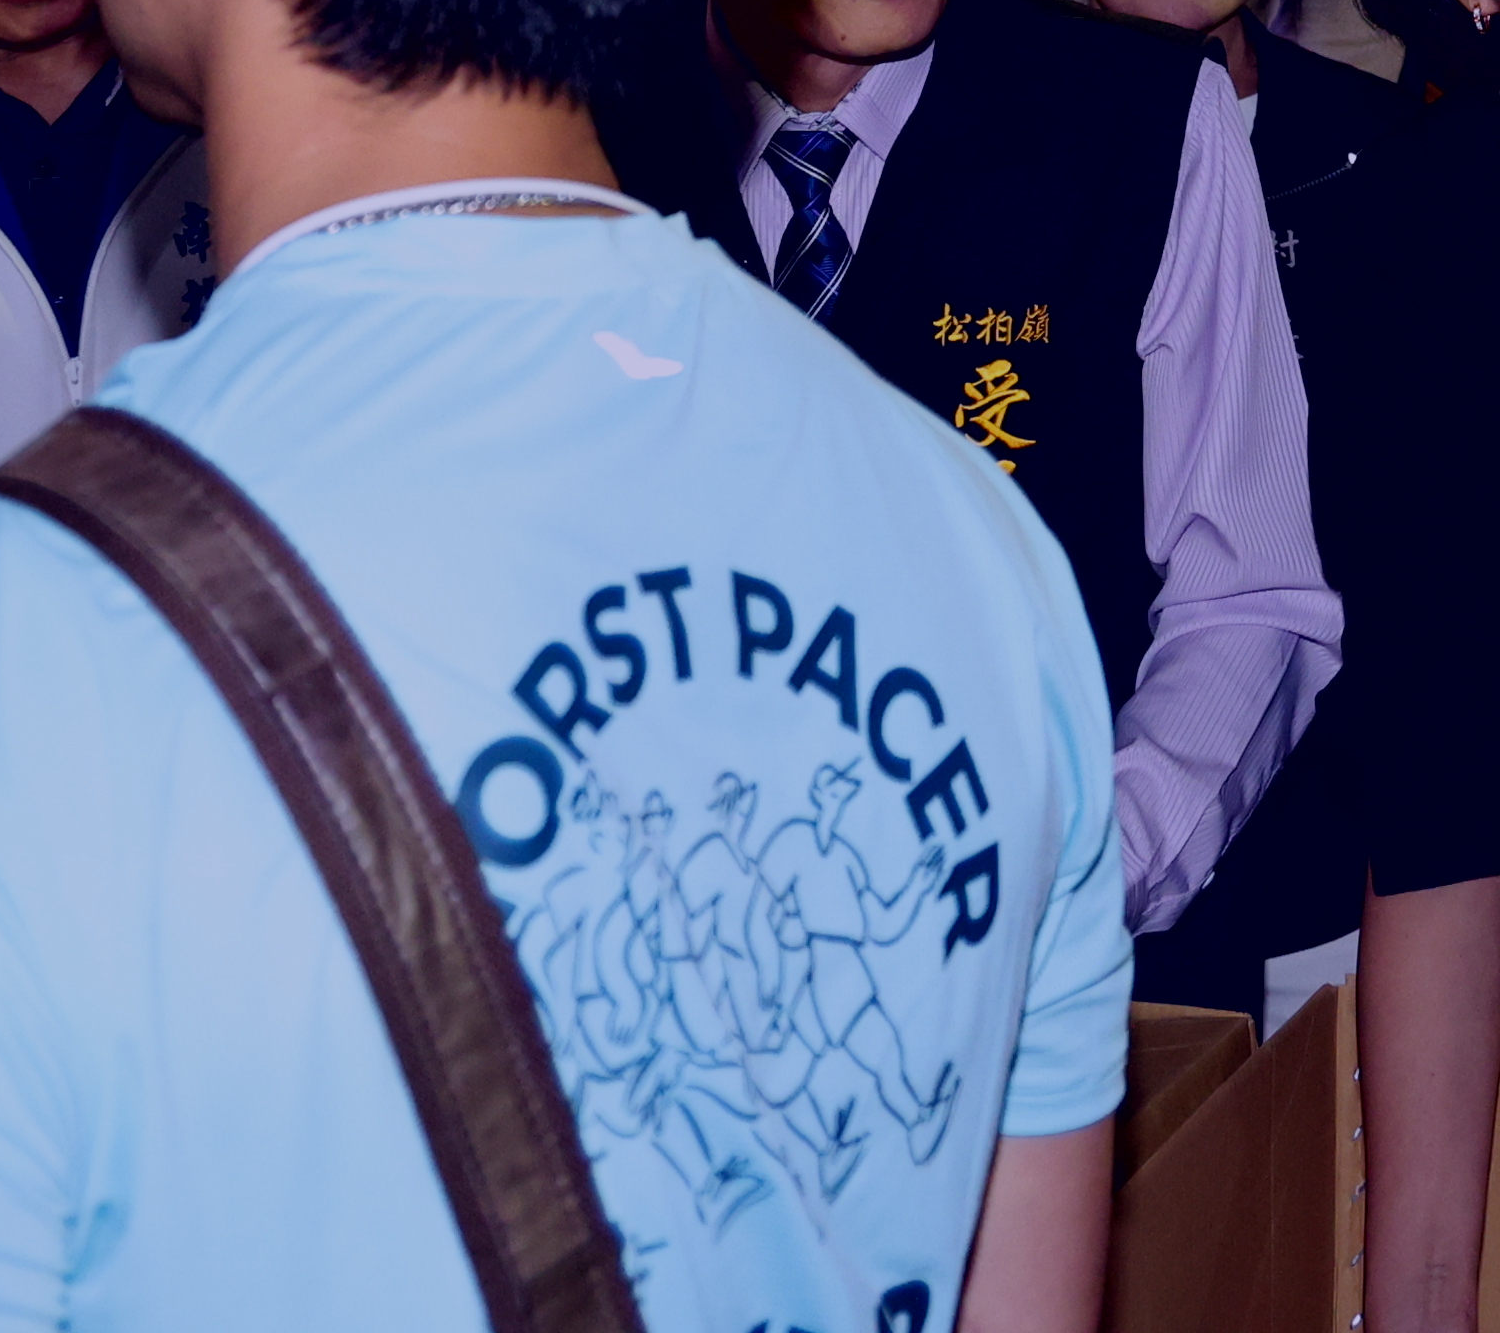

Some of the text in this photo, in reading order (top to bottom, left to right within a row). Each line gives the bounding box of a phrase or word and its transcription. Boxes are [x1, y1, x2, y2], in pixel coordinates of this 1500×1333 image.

[930, 302, 1052, 347] 松柏嶺
[954, 358, 1038, 476] 受
[457, 565, 1001, 961] ORST PACER
